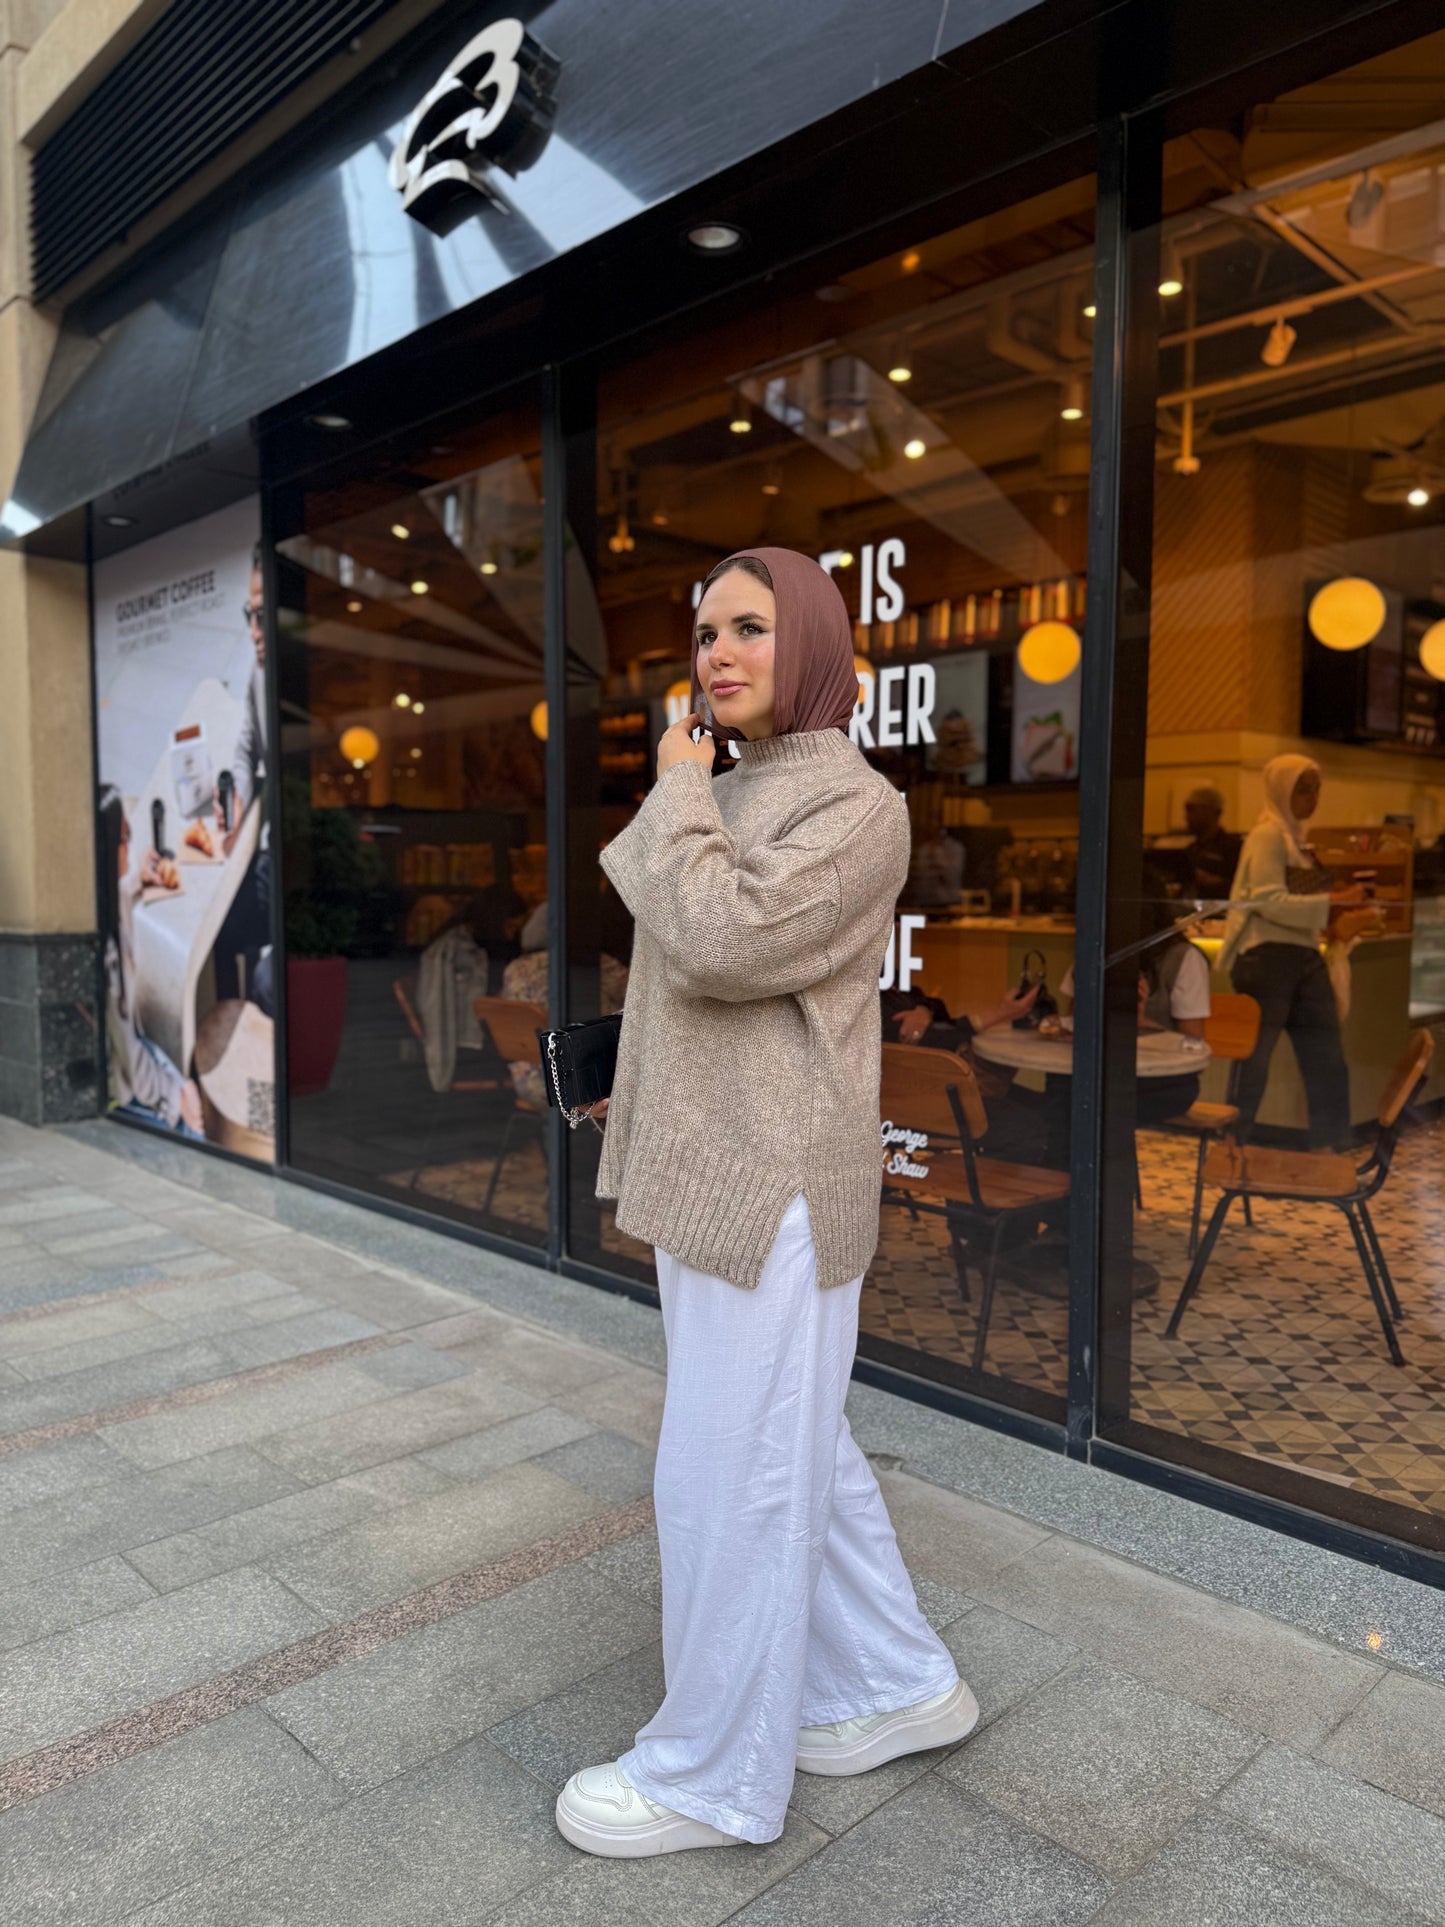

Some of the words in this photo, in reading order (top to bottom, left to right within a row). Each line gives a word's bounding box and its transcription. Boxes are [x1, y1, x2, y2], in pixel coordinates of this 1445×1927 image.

[171, 569, 215, 604] COFFEE
[860, 537, 906, 626] IS
[880, 1120, 928, 1154] George
[886, 1152, 929, 1179] Shaw
